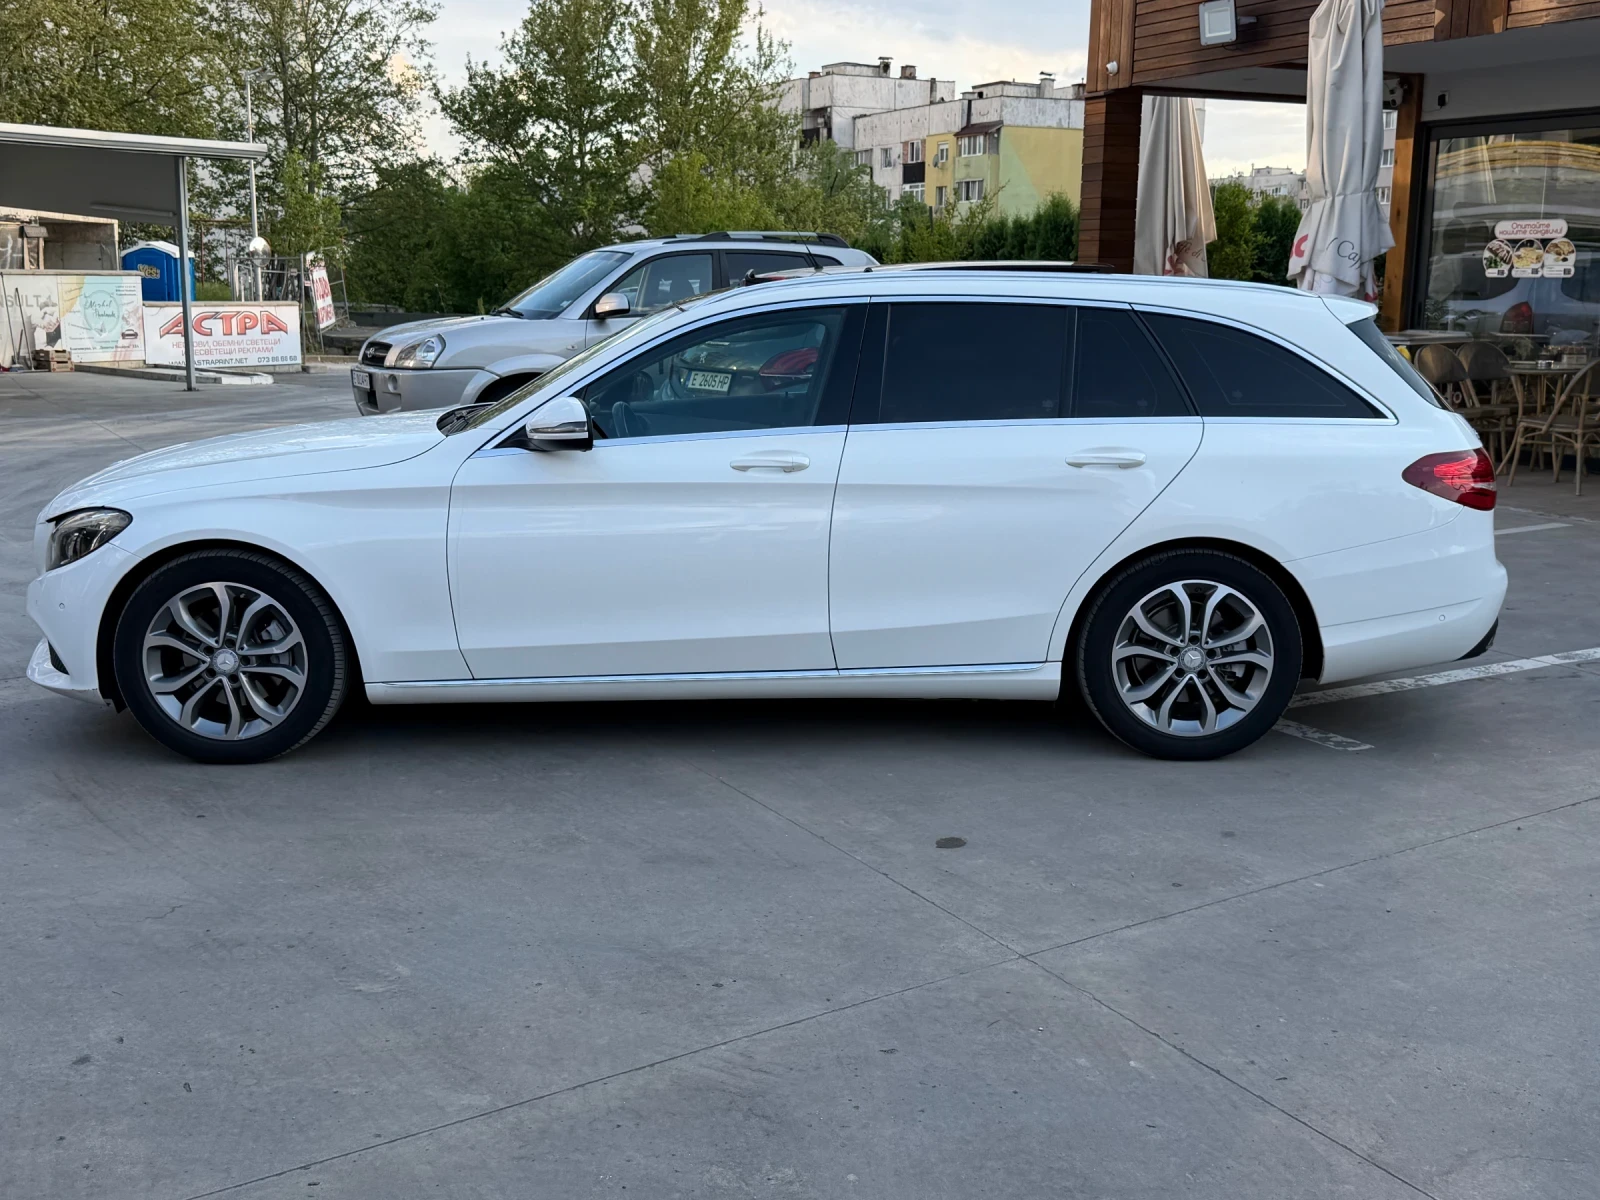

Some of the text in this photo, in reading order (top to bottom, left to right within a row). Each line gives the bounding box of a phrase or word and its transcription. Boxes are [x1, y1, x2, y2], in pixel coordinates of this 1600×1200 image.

[159, 310, 288, 339] АСТРА
[172, 338, 281, 349] НЕОВИ, ОБЕМНИ СВЕТЕЩИ
[194, 348, 237, 356] ЕСВЕТЕЩИ
[691, 373, 699, 386] E
[699, 374, 718, 388] 2605
